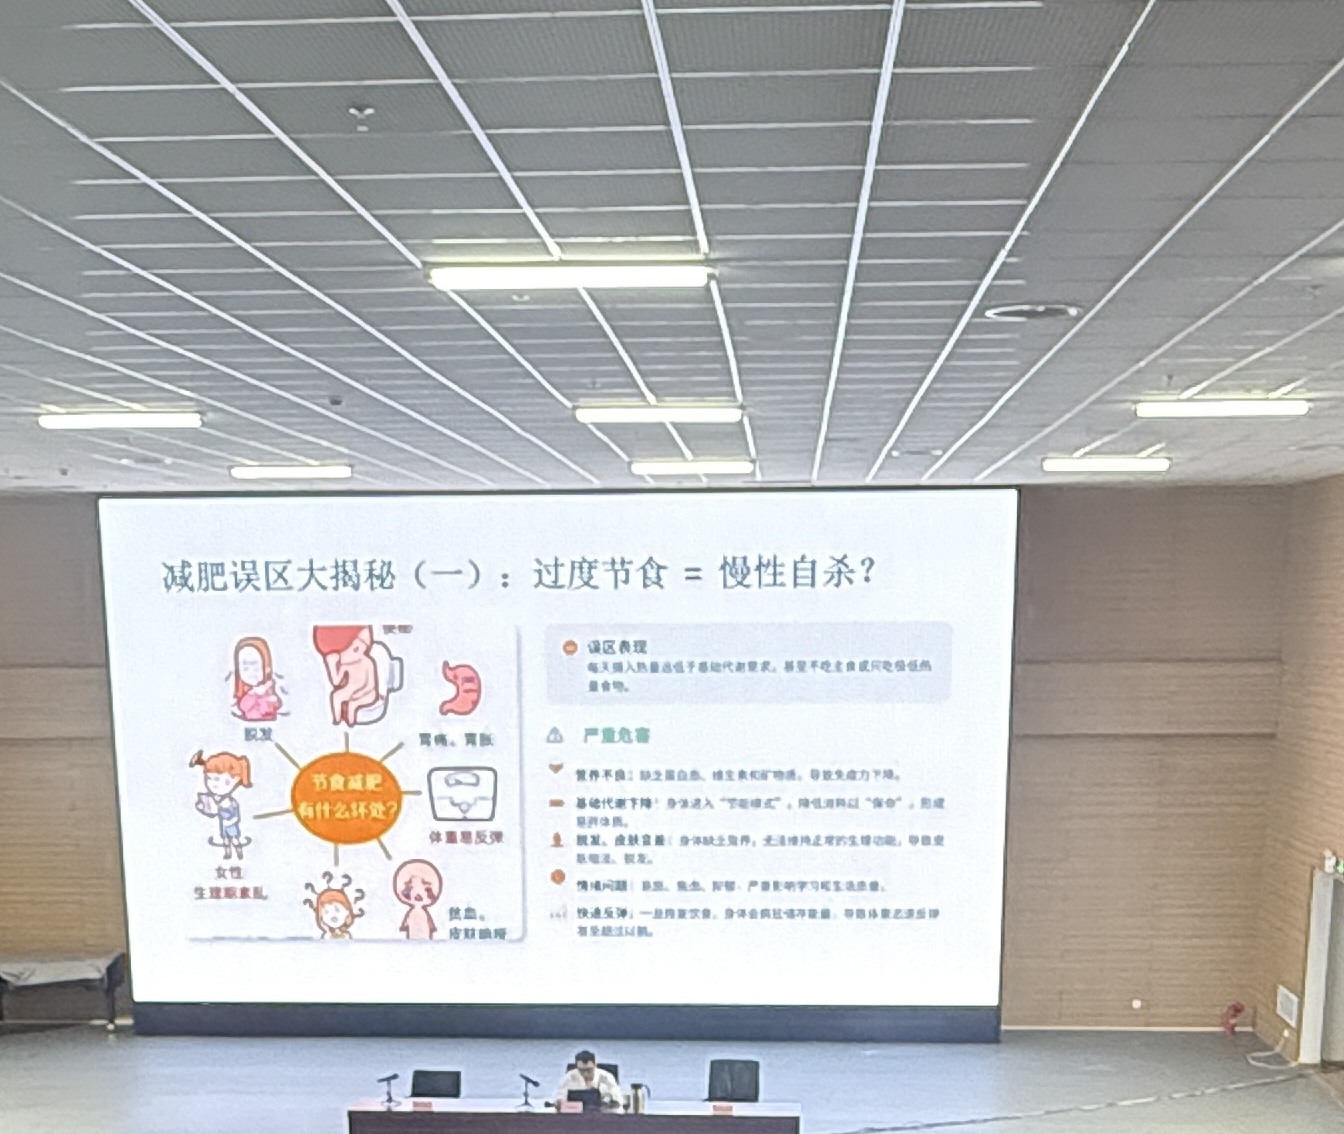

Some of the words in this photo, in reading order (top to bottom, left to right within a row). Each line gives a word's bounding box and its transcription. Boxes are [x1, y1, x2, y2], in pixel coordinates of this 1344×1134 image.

[161, 556, 668, 593] 减肥误区大揭秘（一）：过度节食
[684, 567, 702, 581] =
[587, 640, 647, 655] 误区表现
[584, 727, 650, 743] 严重危害
[313, 773, 383, 792] 节食减肥
[429, 830, 503, 845] 体重易反弹
[215, 866, 243, 879] 女性
